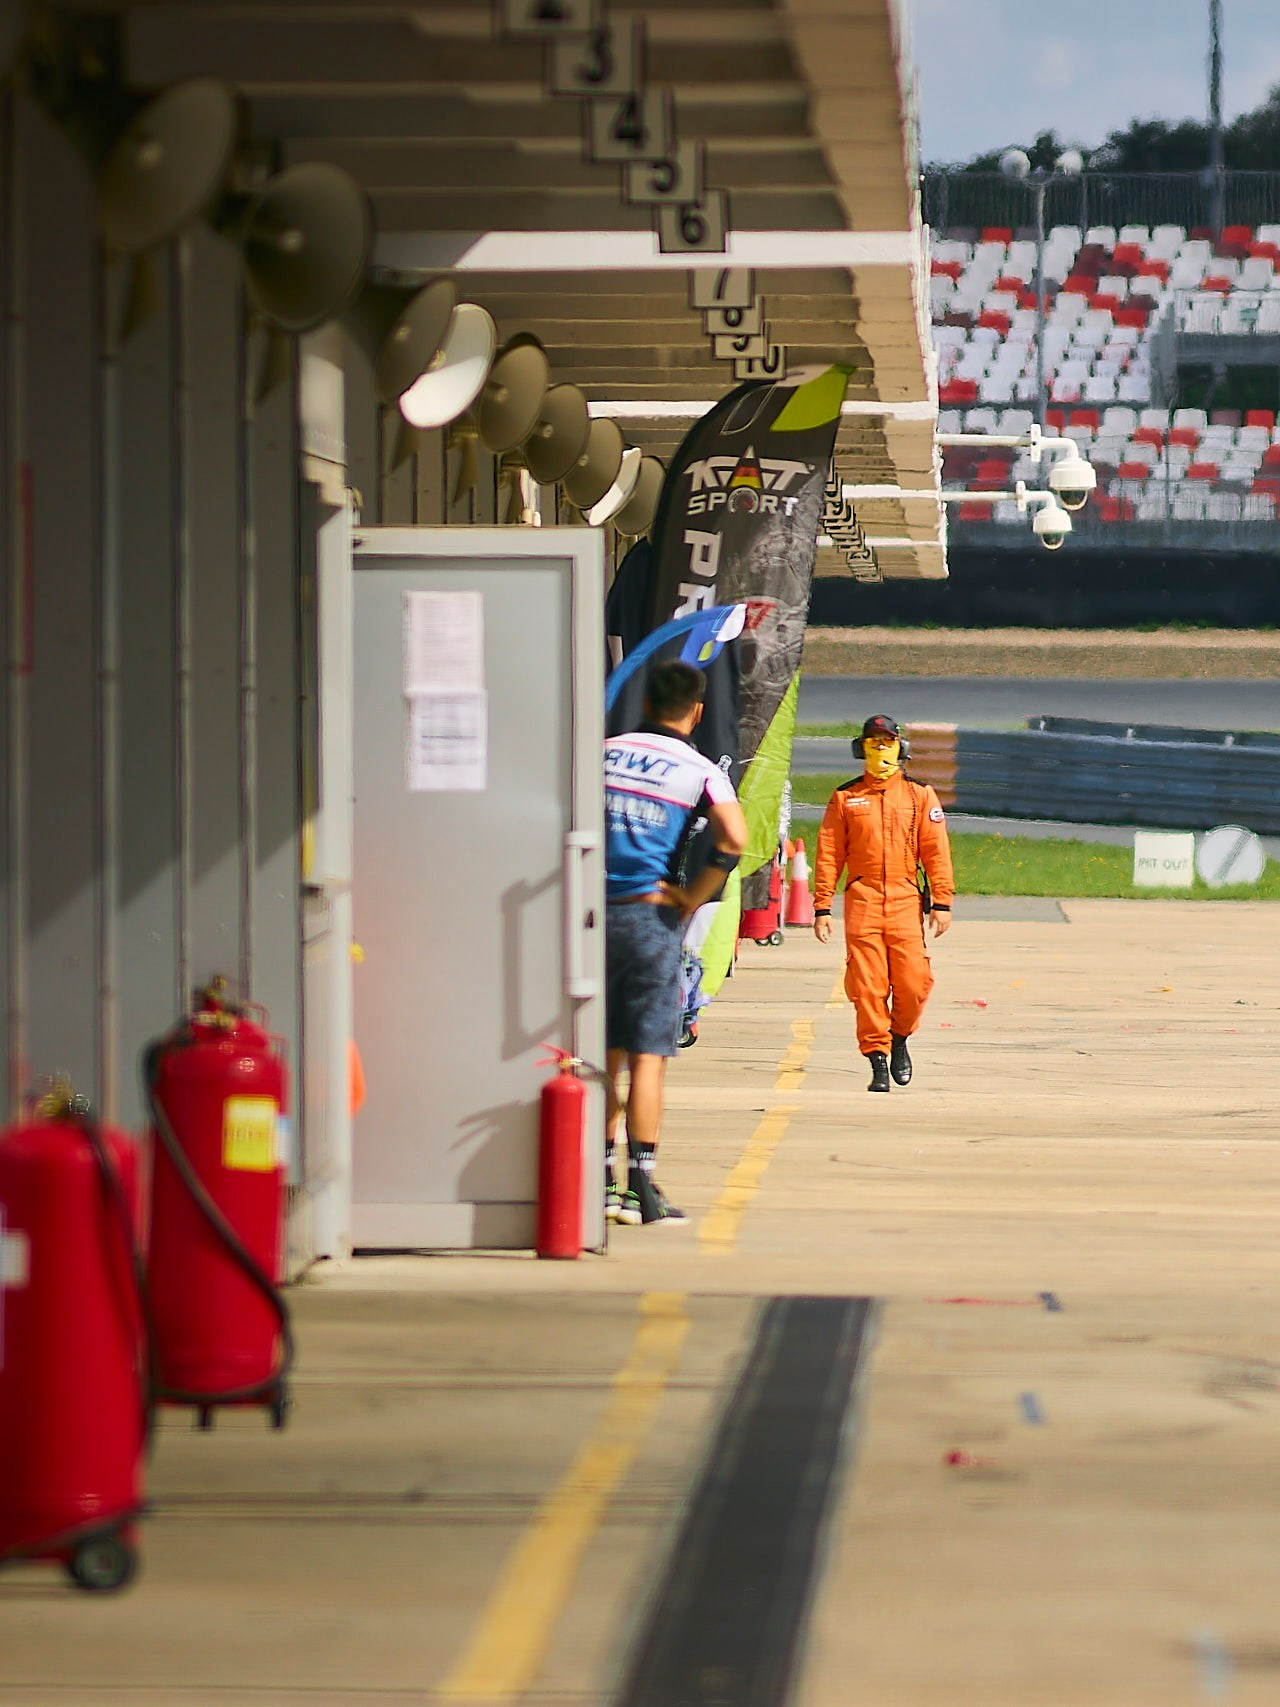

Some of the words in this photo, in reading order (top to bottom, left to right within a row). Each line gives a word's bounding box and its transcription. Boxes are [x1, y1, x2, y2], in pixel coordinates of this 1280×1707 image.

[612, 97, 646, 150] 4
[680, 204, 707, 244] 6
[687, 487, 799, 516] SPORT
[1138, 857, 1158, 869] PIT
